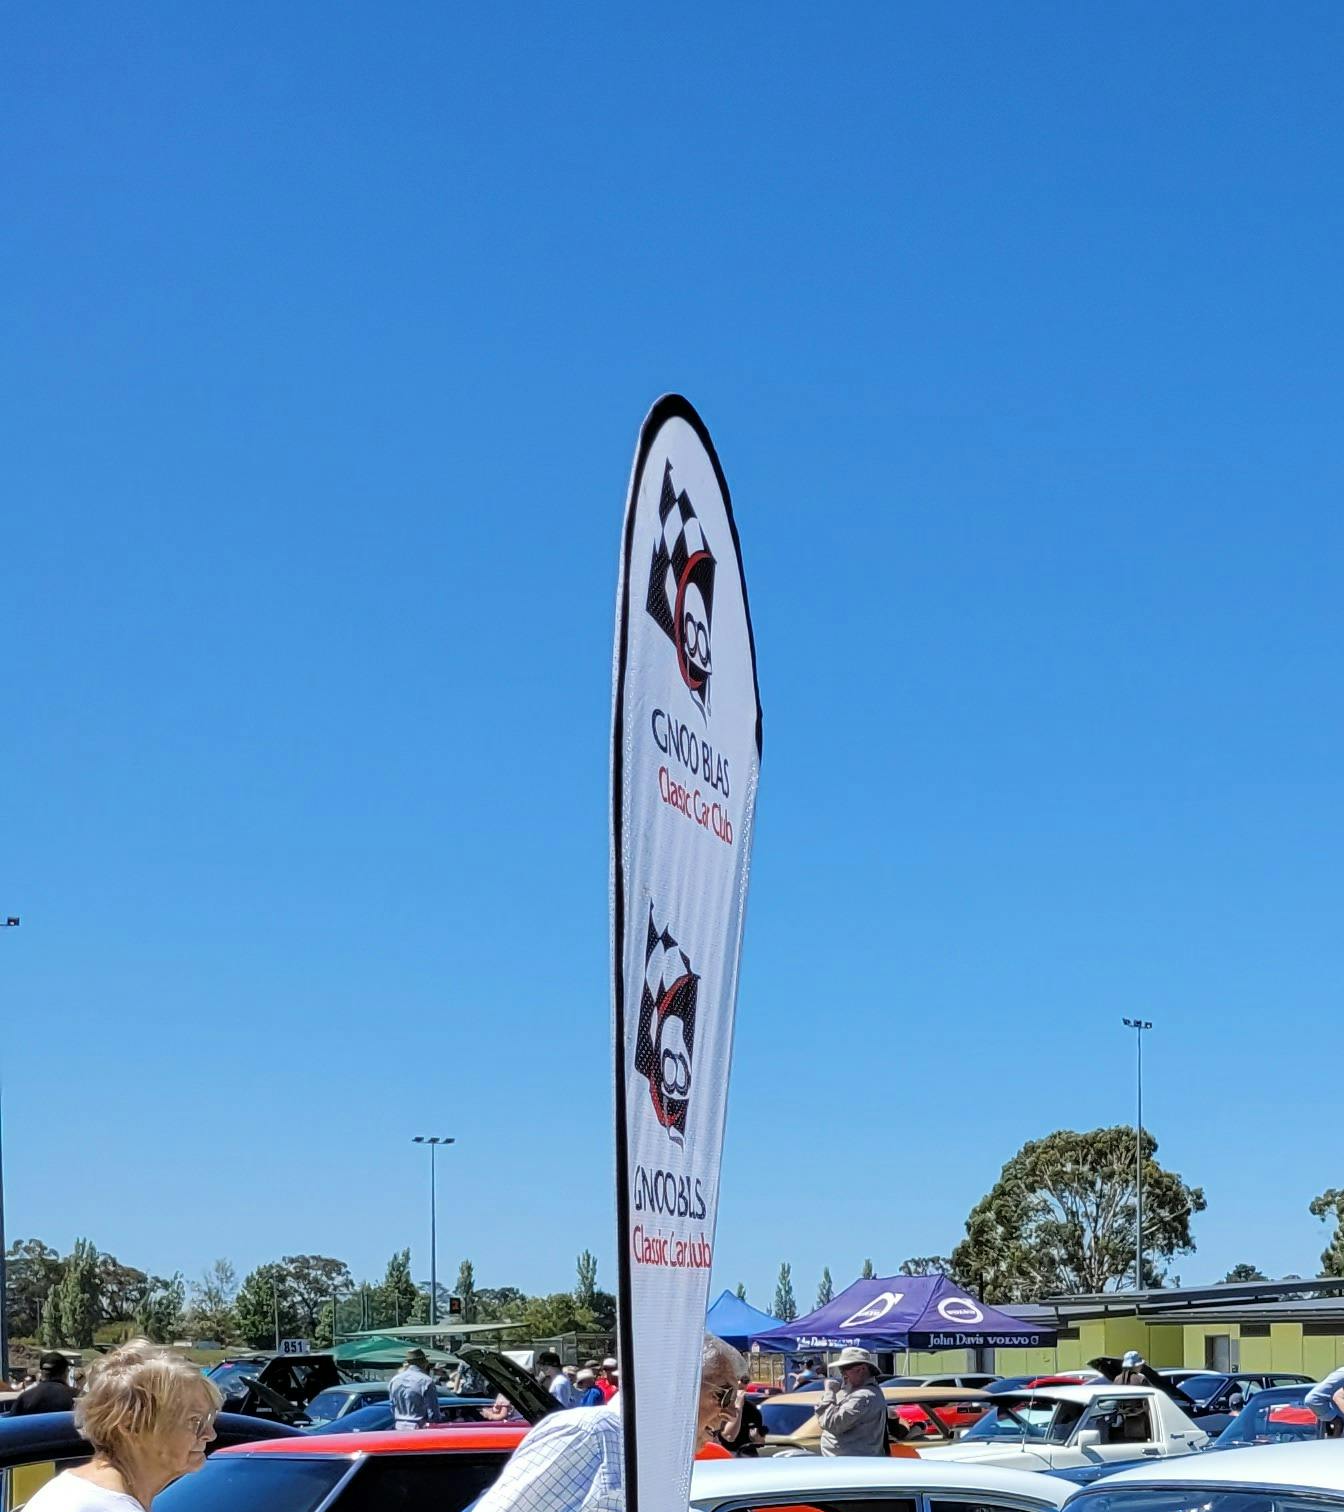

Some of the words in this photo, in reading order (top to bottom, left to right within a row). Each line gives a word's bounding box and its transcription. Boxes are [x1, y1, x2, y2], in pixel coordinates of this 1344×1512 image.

[651, 708, 699, 775] GNOO
[702, 740, 729, 798] BLAS
[693, 789, 710, 830] Car
[711, 802, 732, 845] Club
[677, 1175, 706, 1220] BLS
[633, 1224, 668, 1266] Classic
[687, 1232, 712, 1269] lub
[284, 1341, 303, 1353] 851
[928, 1333, 954, 1348] John
[955, 1333, 984, 1346] Davis
[986, 1336, 1030, 1345] VOLVO
